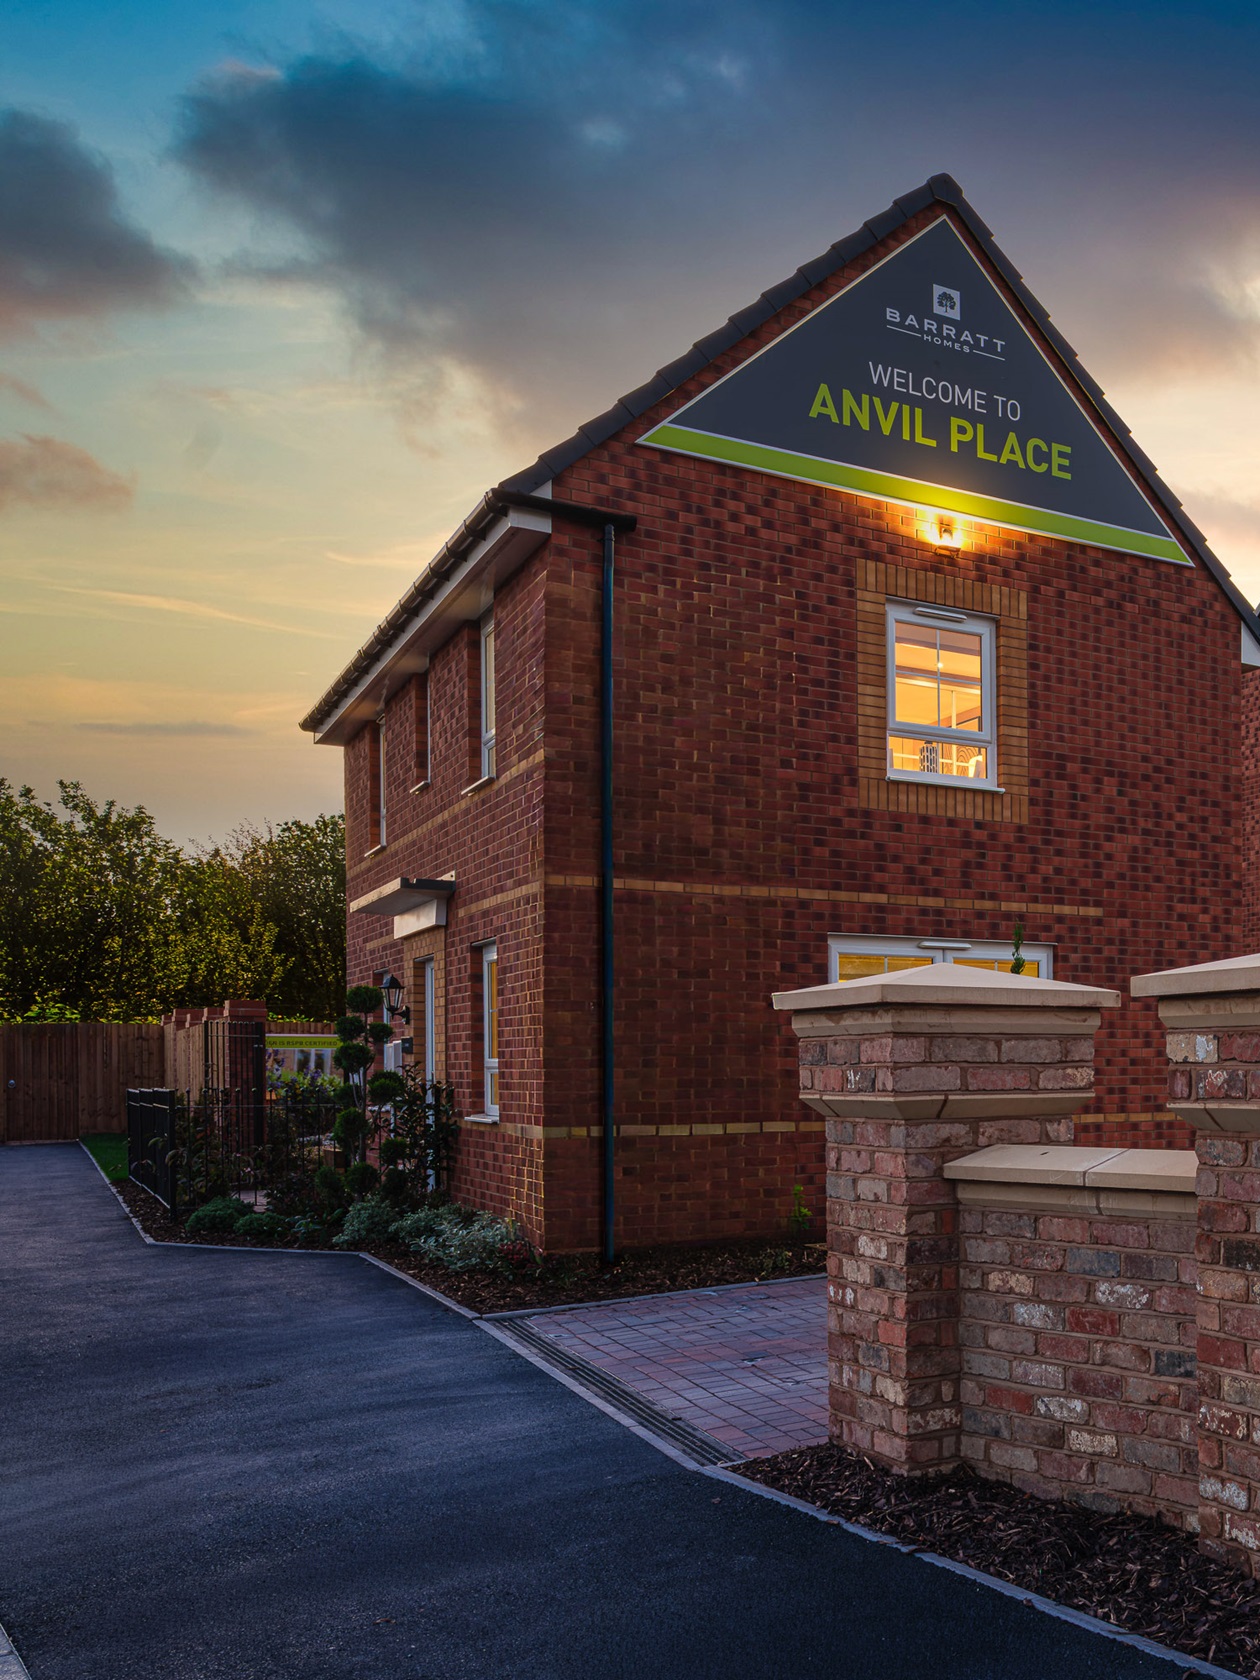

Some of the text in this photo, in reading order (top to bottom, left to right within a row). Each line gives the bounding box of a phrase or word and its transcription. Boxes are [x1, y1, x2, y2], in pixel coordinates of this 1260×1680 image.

[886, 307, 1006, 353] BARRATT
[923, 334, 970, 353] HOMES
[868, 361, 1021, 421] WELCOME TO
[808, 383, 1072, 481] ANVIL PLACE
